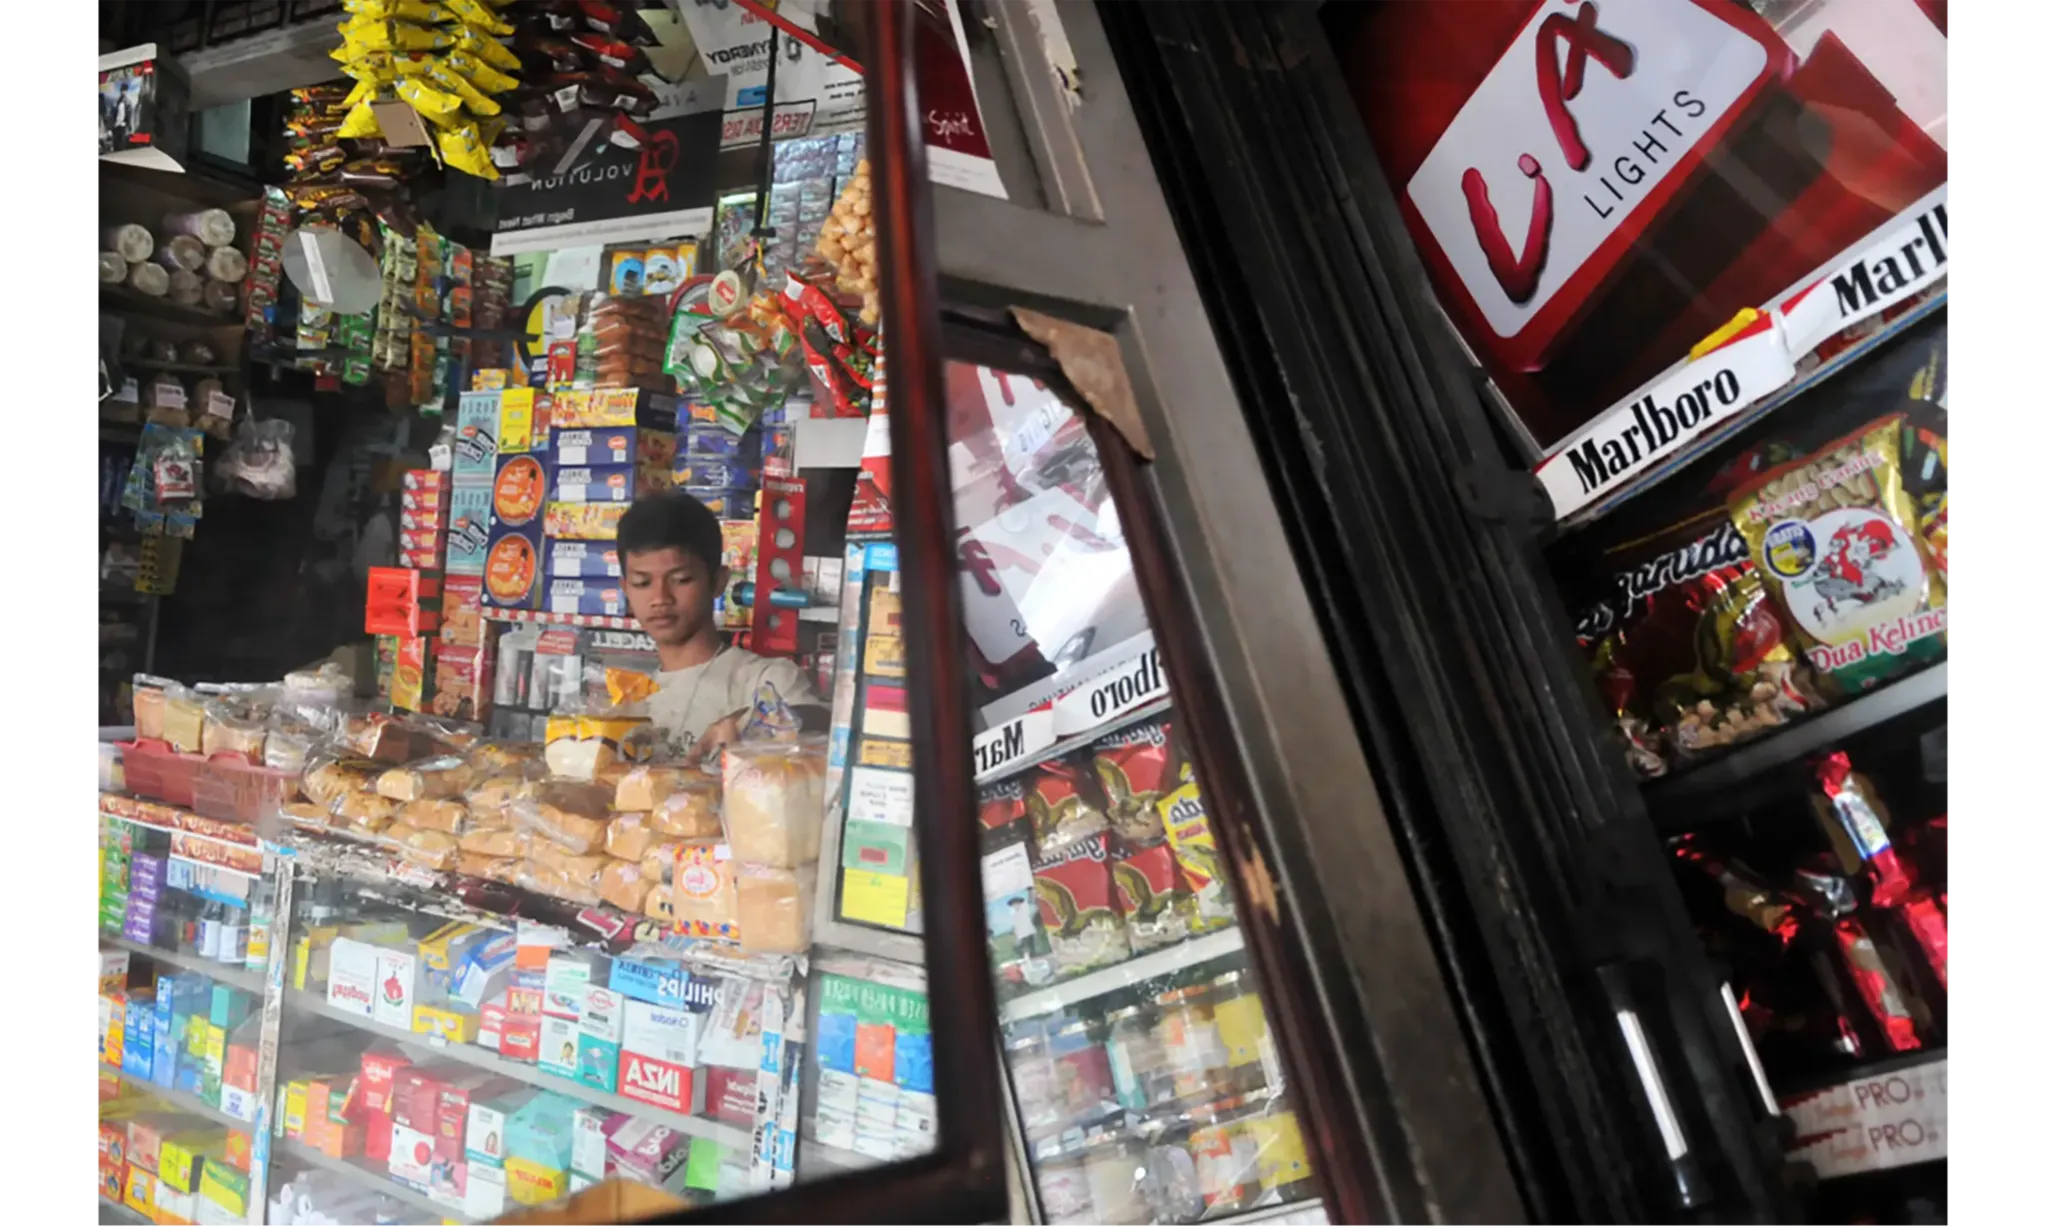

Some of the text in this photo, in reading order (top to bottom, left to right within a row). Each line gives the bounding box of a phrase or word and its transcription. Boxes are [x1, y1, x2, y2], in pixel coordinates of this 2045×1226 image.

[928, 109, 975, 145] Spirit
[1584, 90, 1706, 219] LIGHTS
[1566, 367, 1741, 495] Marlboro
[1616, 521, 1750, 617] garuda
[1809, 641, 1864, 673] Dua
